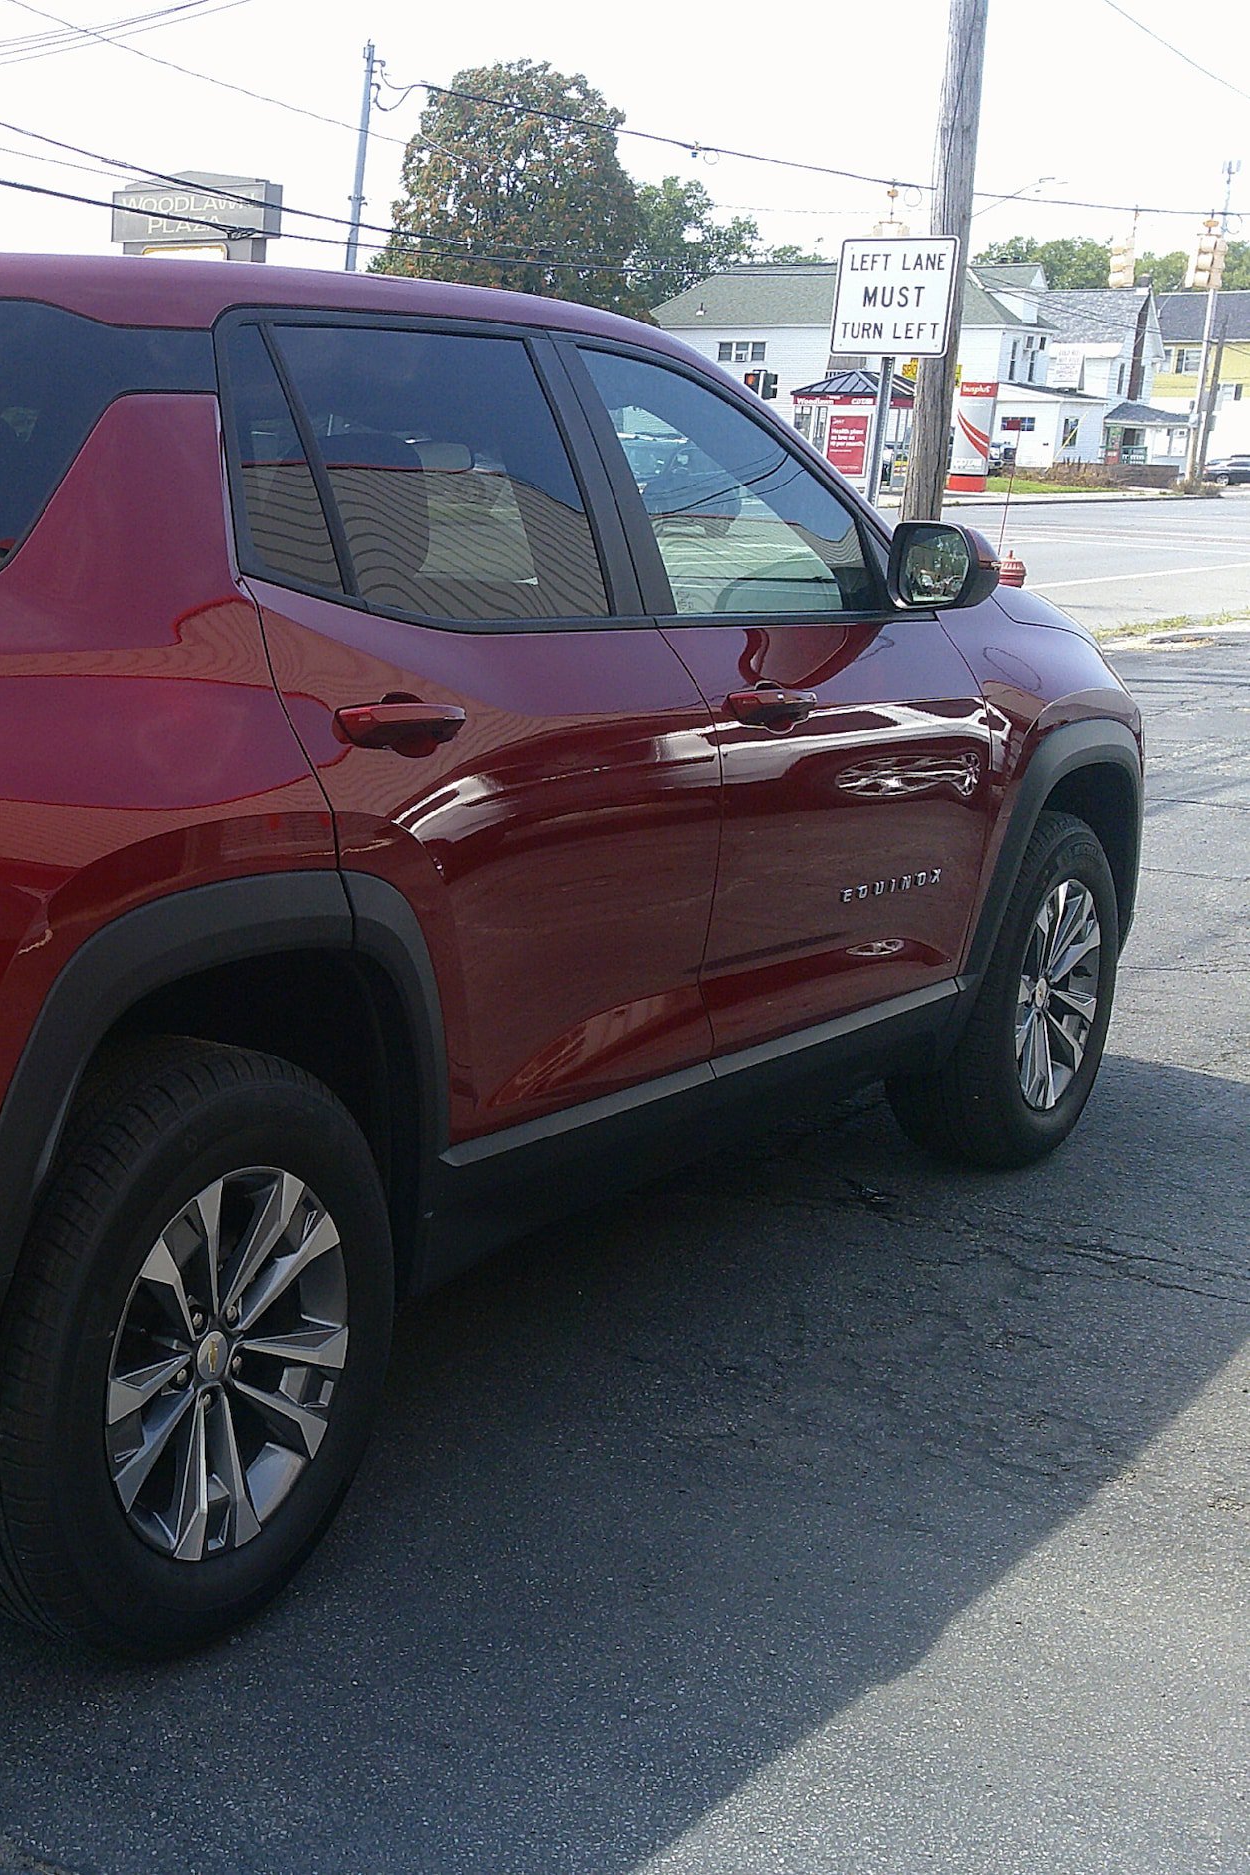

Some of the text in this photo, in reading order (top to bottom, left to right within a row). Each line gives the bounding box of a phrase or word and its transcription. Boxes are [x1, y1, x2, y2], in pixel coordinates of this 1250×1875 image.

[850, 253, 947, 271] LEFT LANE
[862, 286, 926, 308] MUST
[842, 322, 940, 339] TURN LEFT
